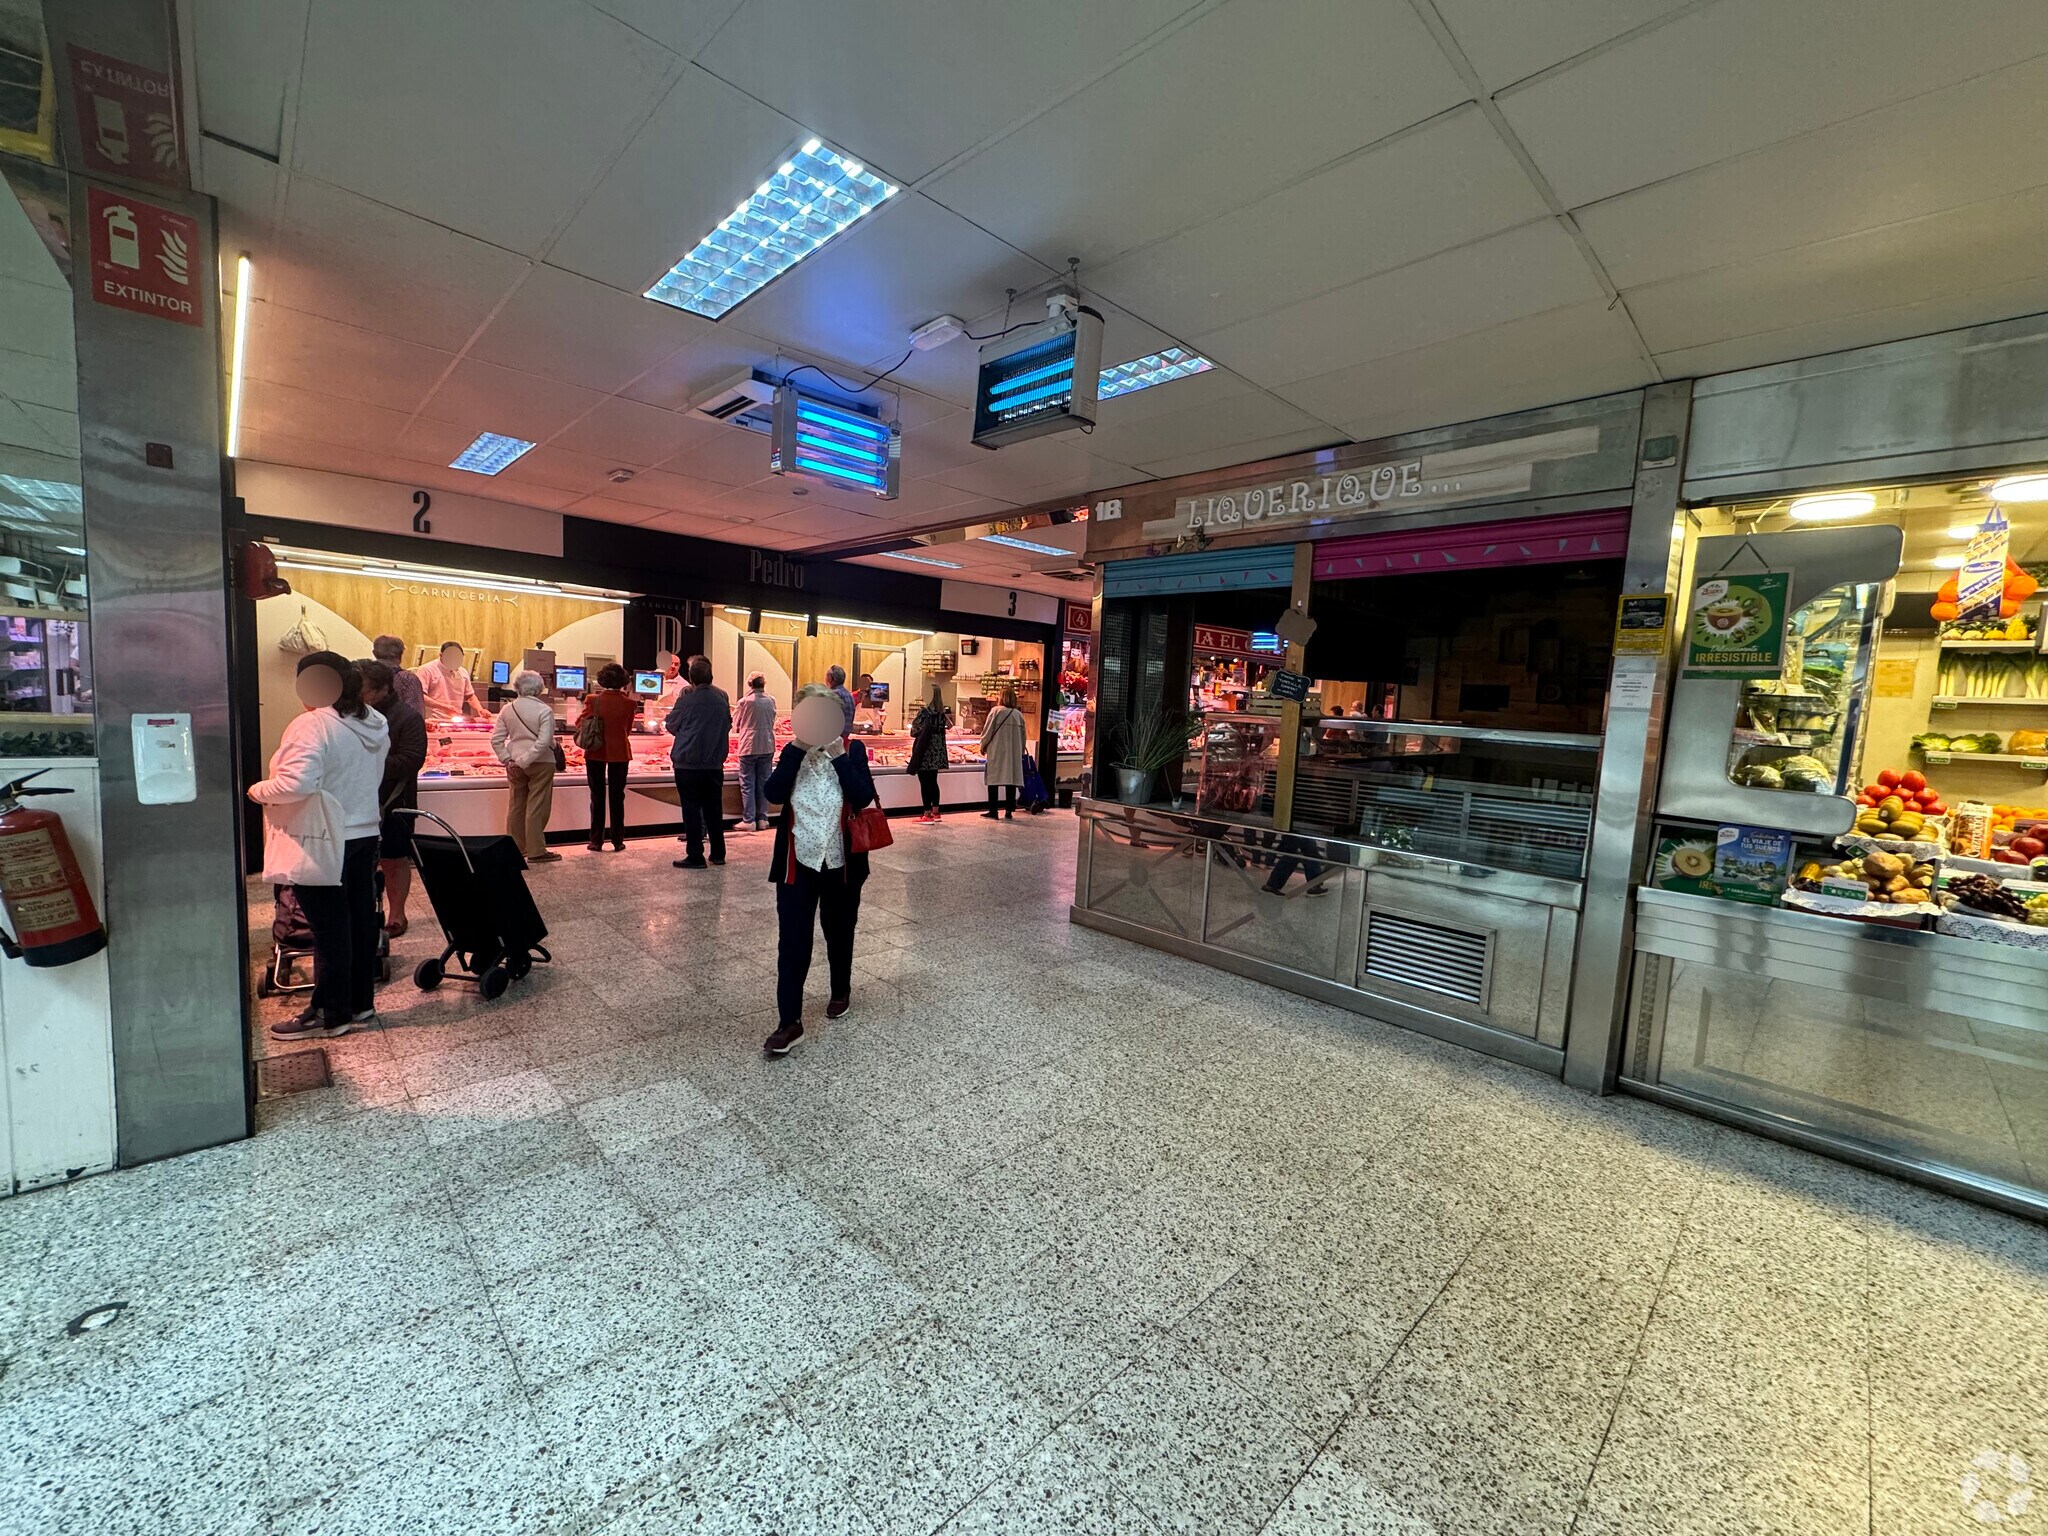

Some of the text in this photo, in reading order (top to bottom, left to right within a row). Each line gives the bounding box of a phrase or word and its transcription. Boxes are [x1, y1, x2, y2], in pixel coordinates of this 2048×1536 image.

[104, 280, 192, 314] EXTINTOR
[413, 491, 431, 533] 2
[1095, 499, 1122, 521] 1B
[749, 549, 805, 589] Pedro
[1008, 592, 1017, 617] 3
[1075, 612, 1085, 626] 4
[1220, 634, 1240, 649] EL
[1695, 652, 1772, 663] IRRESISTIBLE
